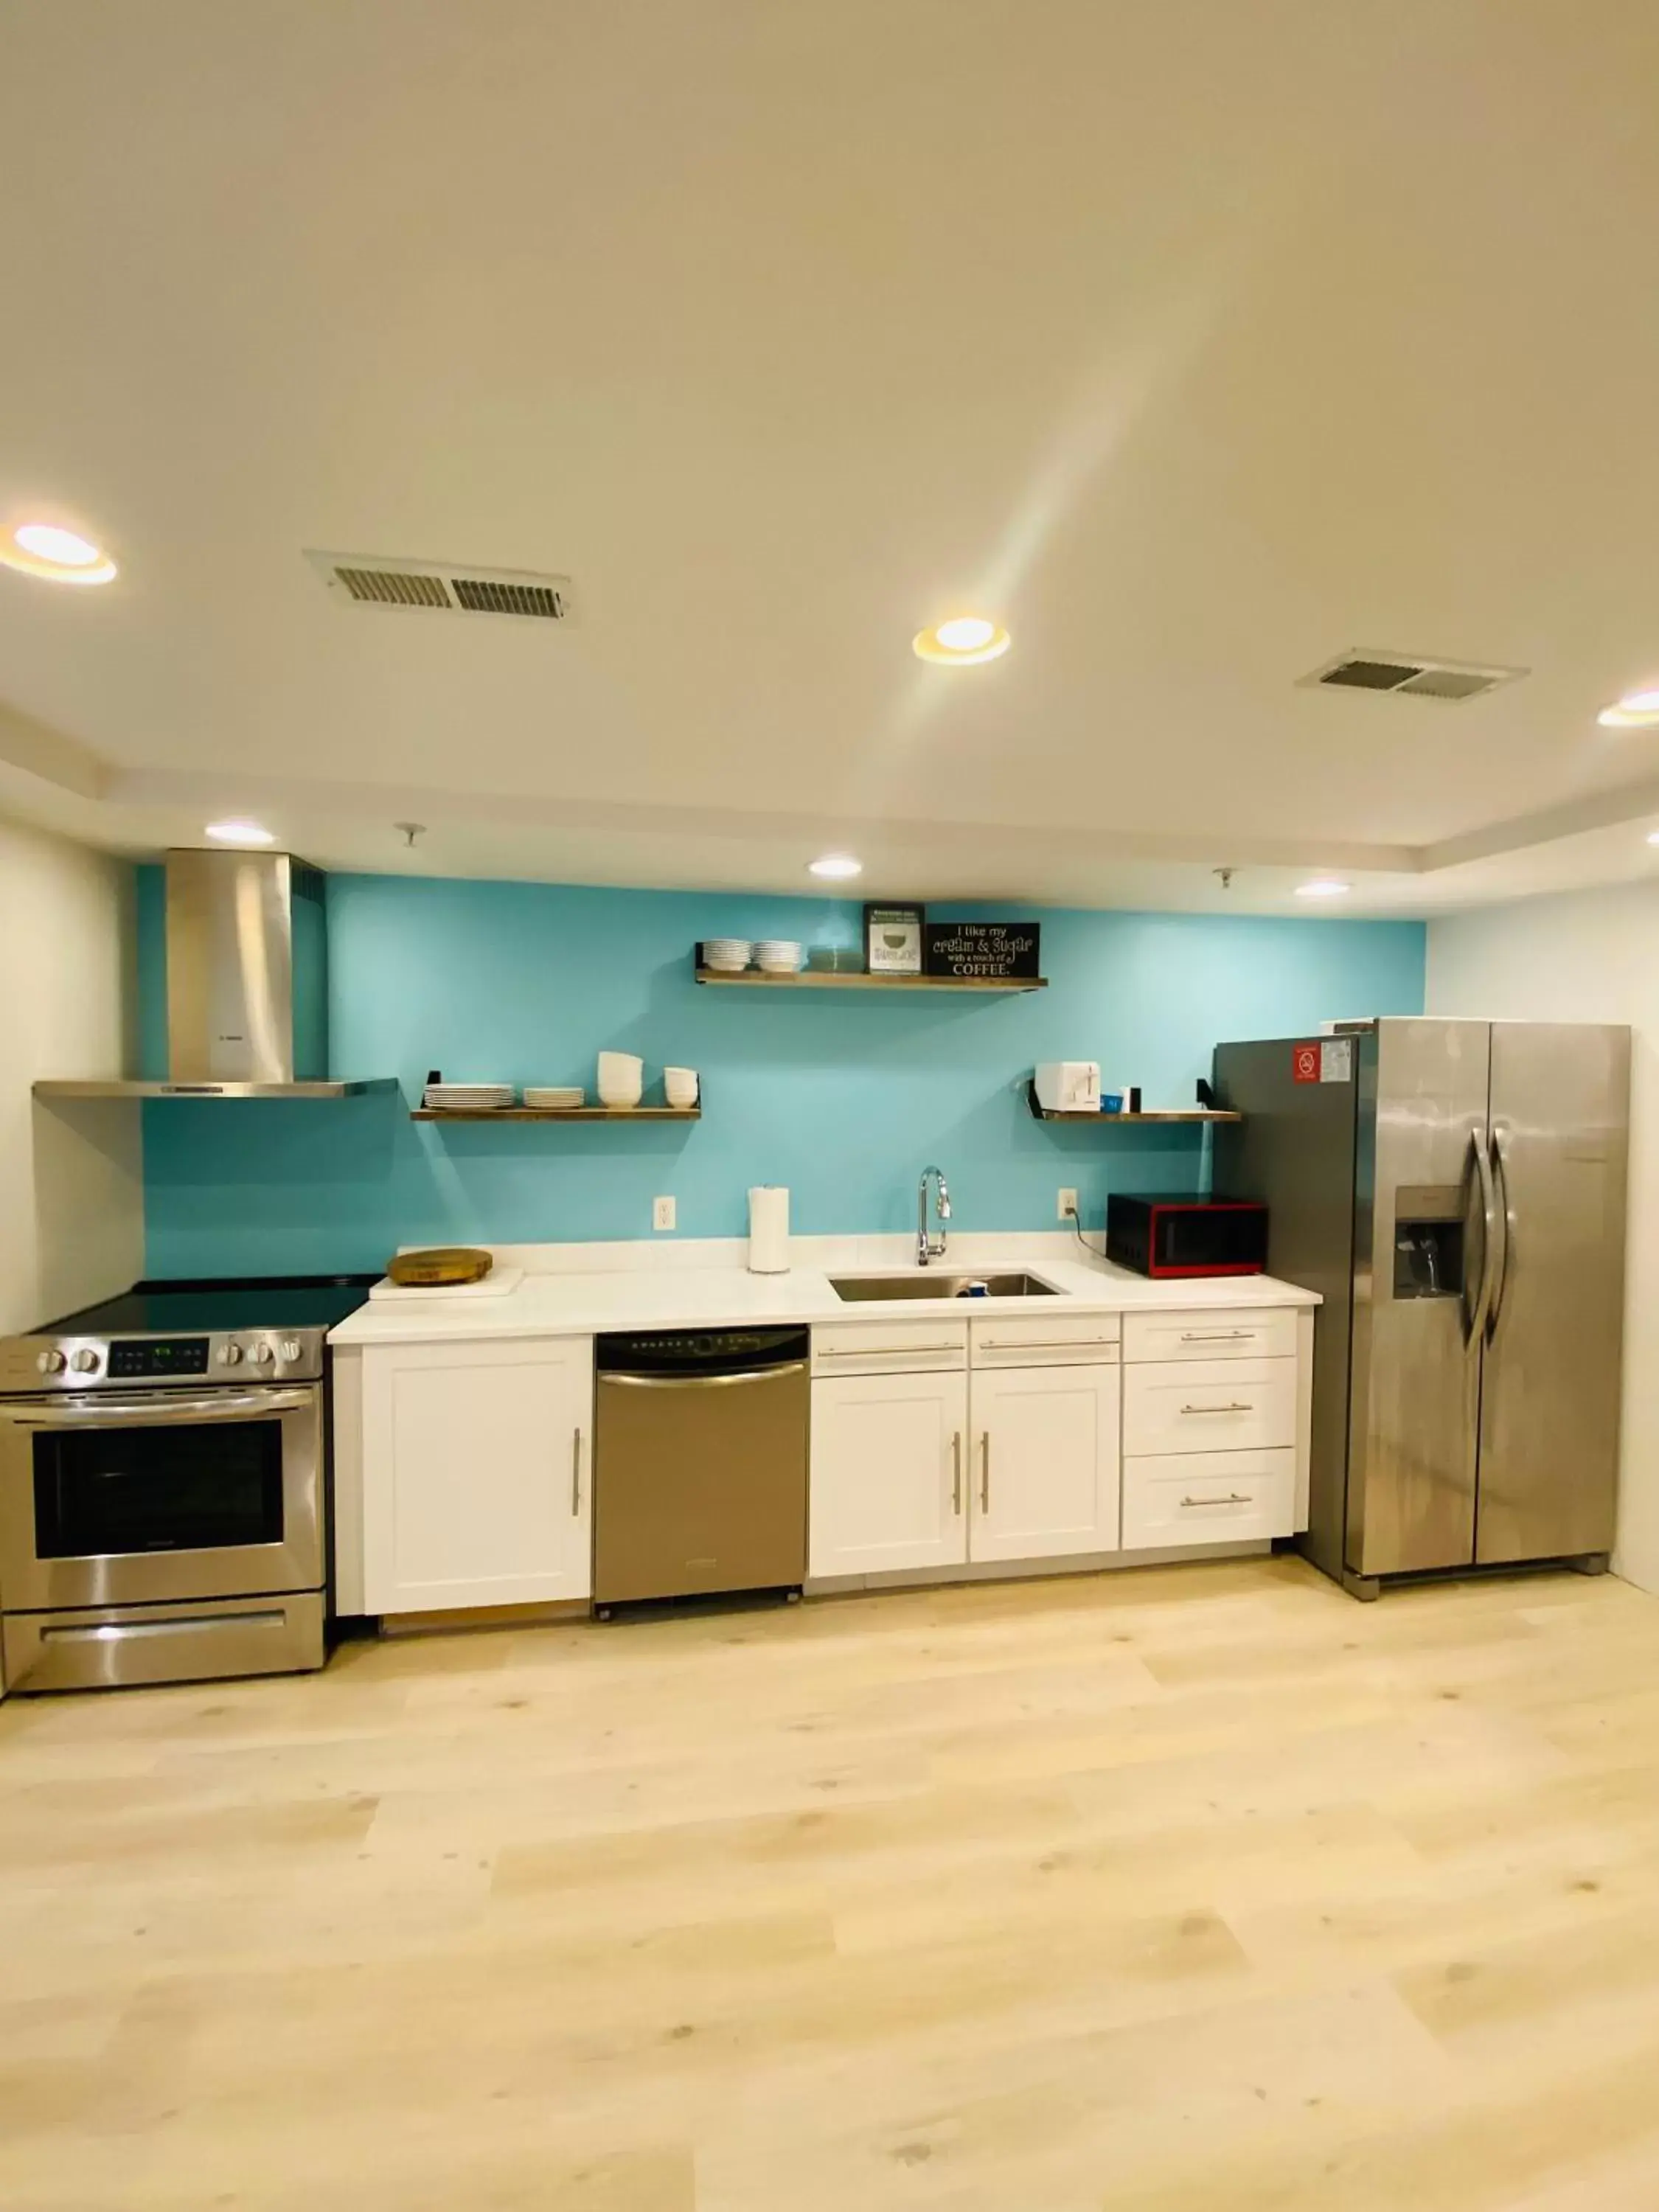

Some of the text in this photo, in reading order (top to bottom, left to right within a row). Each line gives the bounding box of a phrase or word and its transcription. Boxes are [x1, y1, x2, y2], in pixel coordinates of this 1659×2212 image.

[965, 925, 986, 936] like
[989, 928, 1007, 939] my
[933, 937, 974, 953] cream
[978, 939, 990, 954] &
[947, 953, 966, 962] with
[973, 953, 995, 962] touch
[996, 953, 1006, 962] of
